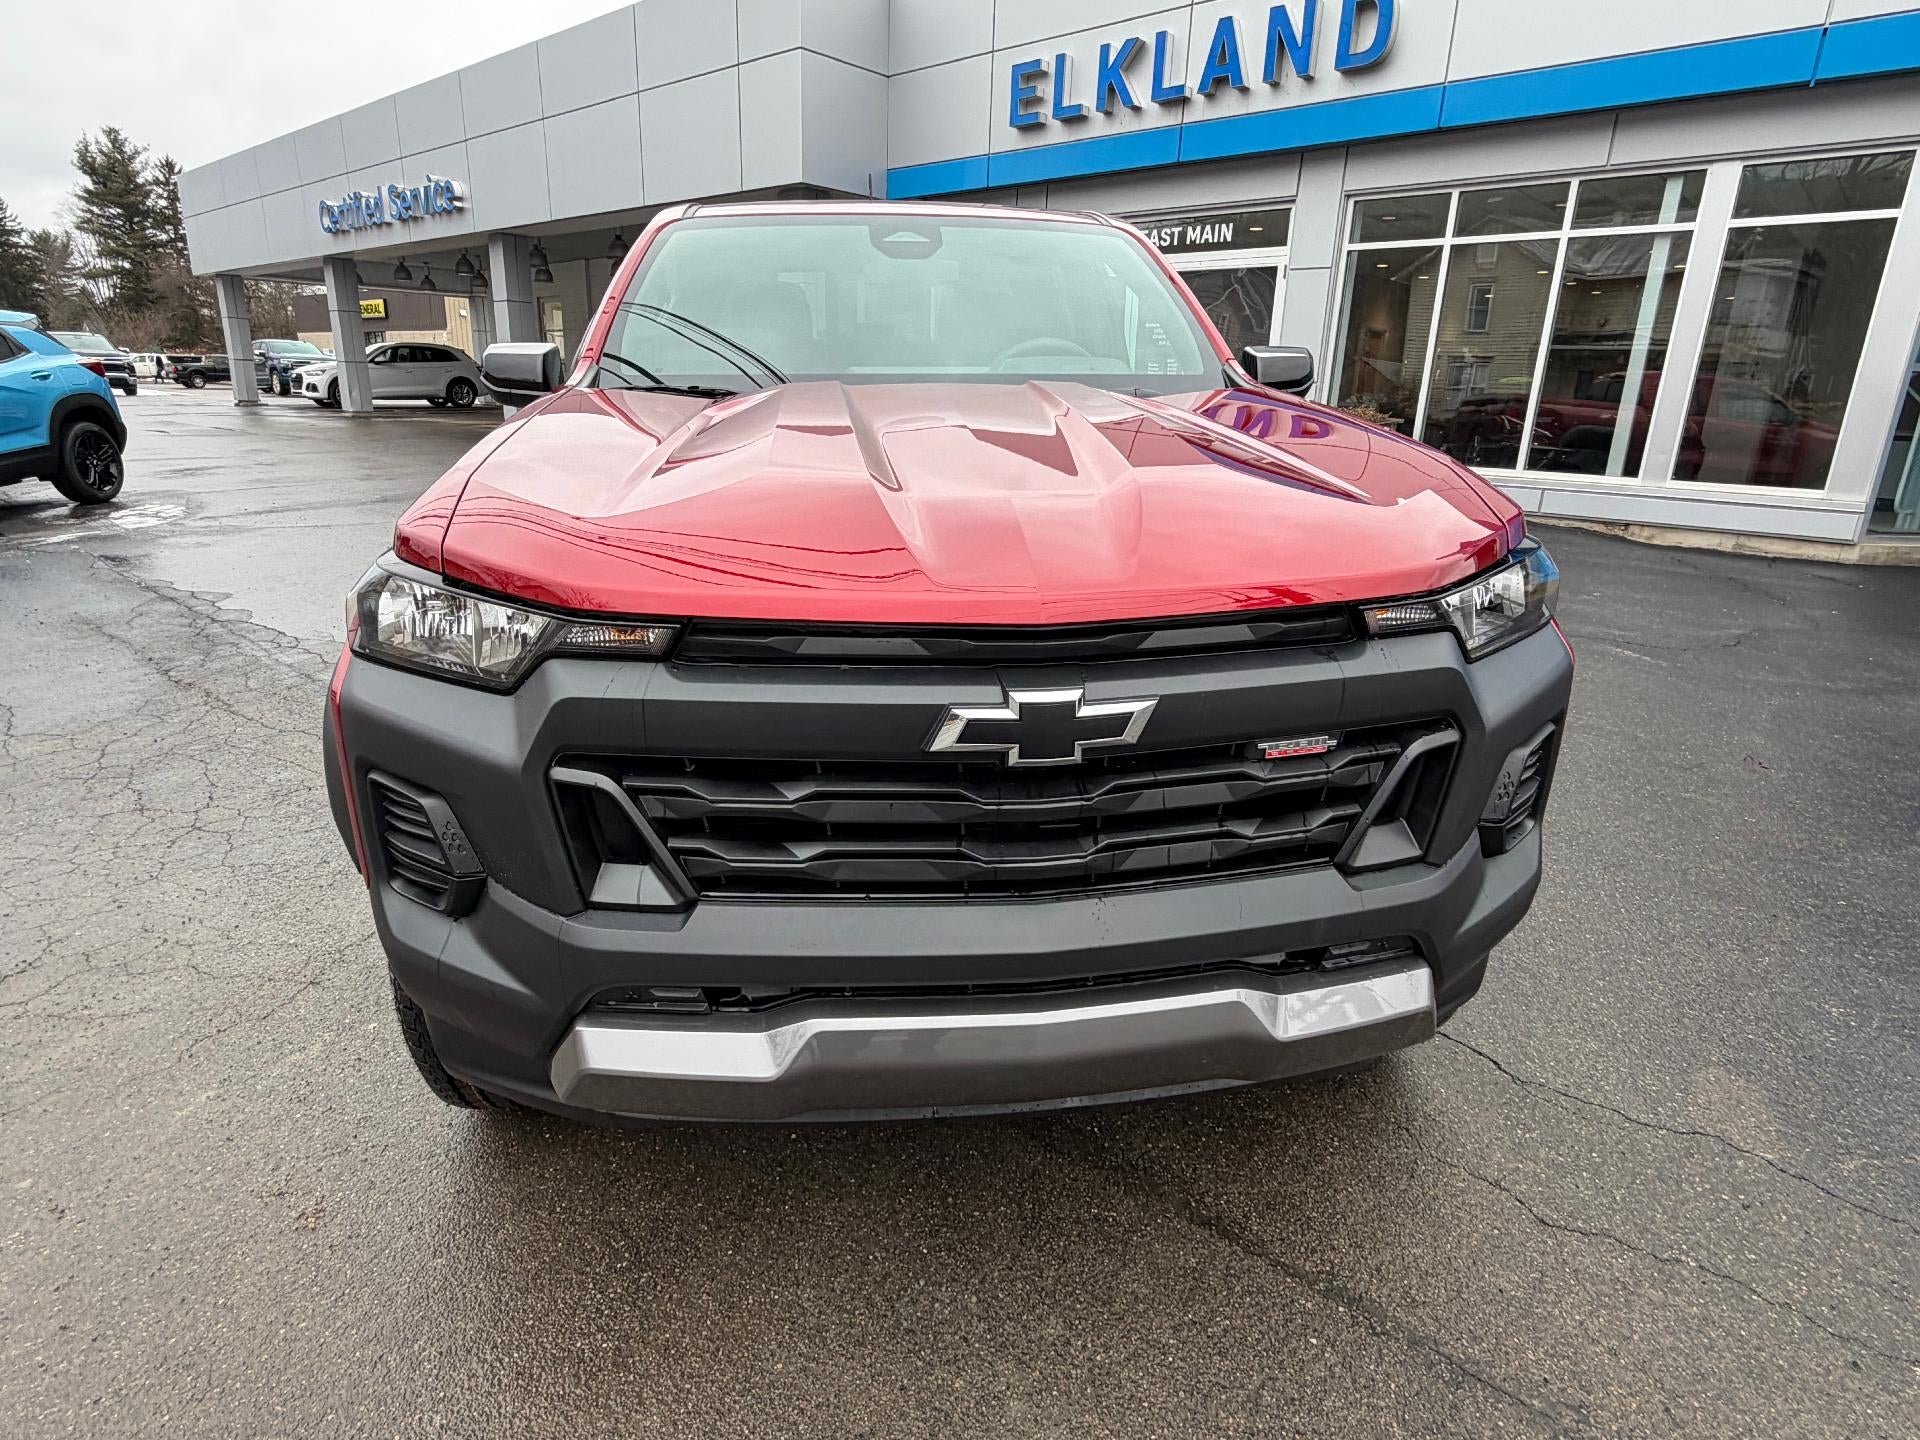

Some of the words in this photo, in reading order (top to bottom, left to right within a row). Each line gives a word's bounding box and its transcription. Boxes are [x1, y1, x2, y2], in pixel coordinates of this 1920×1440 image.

[1009, 0, 1398, 128] ELKLAND
[319, 186, 387, 233] Certified
[388, 174, 460, 221] Service
[1185, 222, 1234, 245] MAIN
